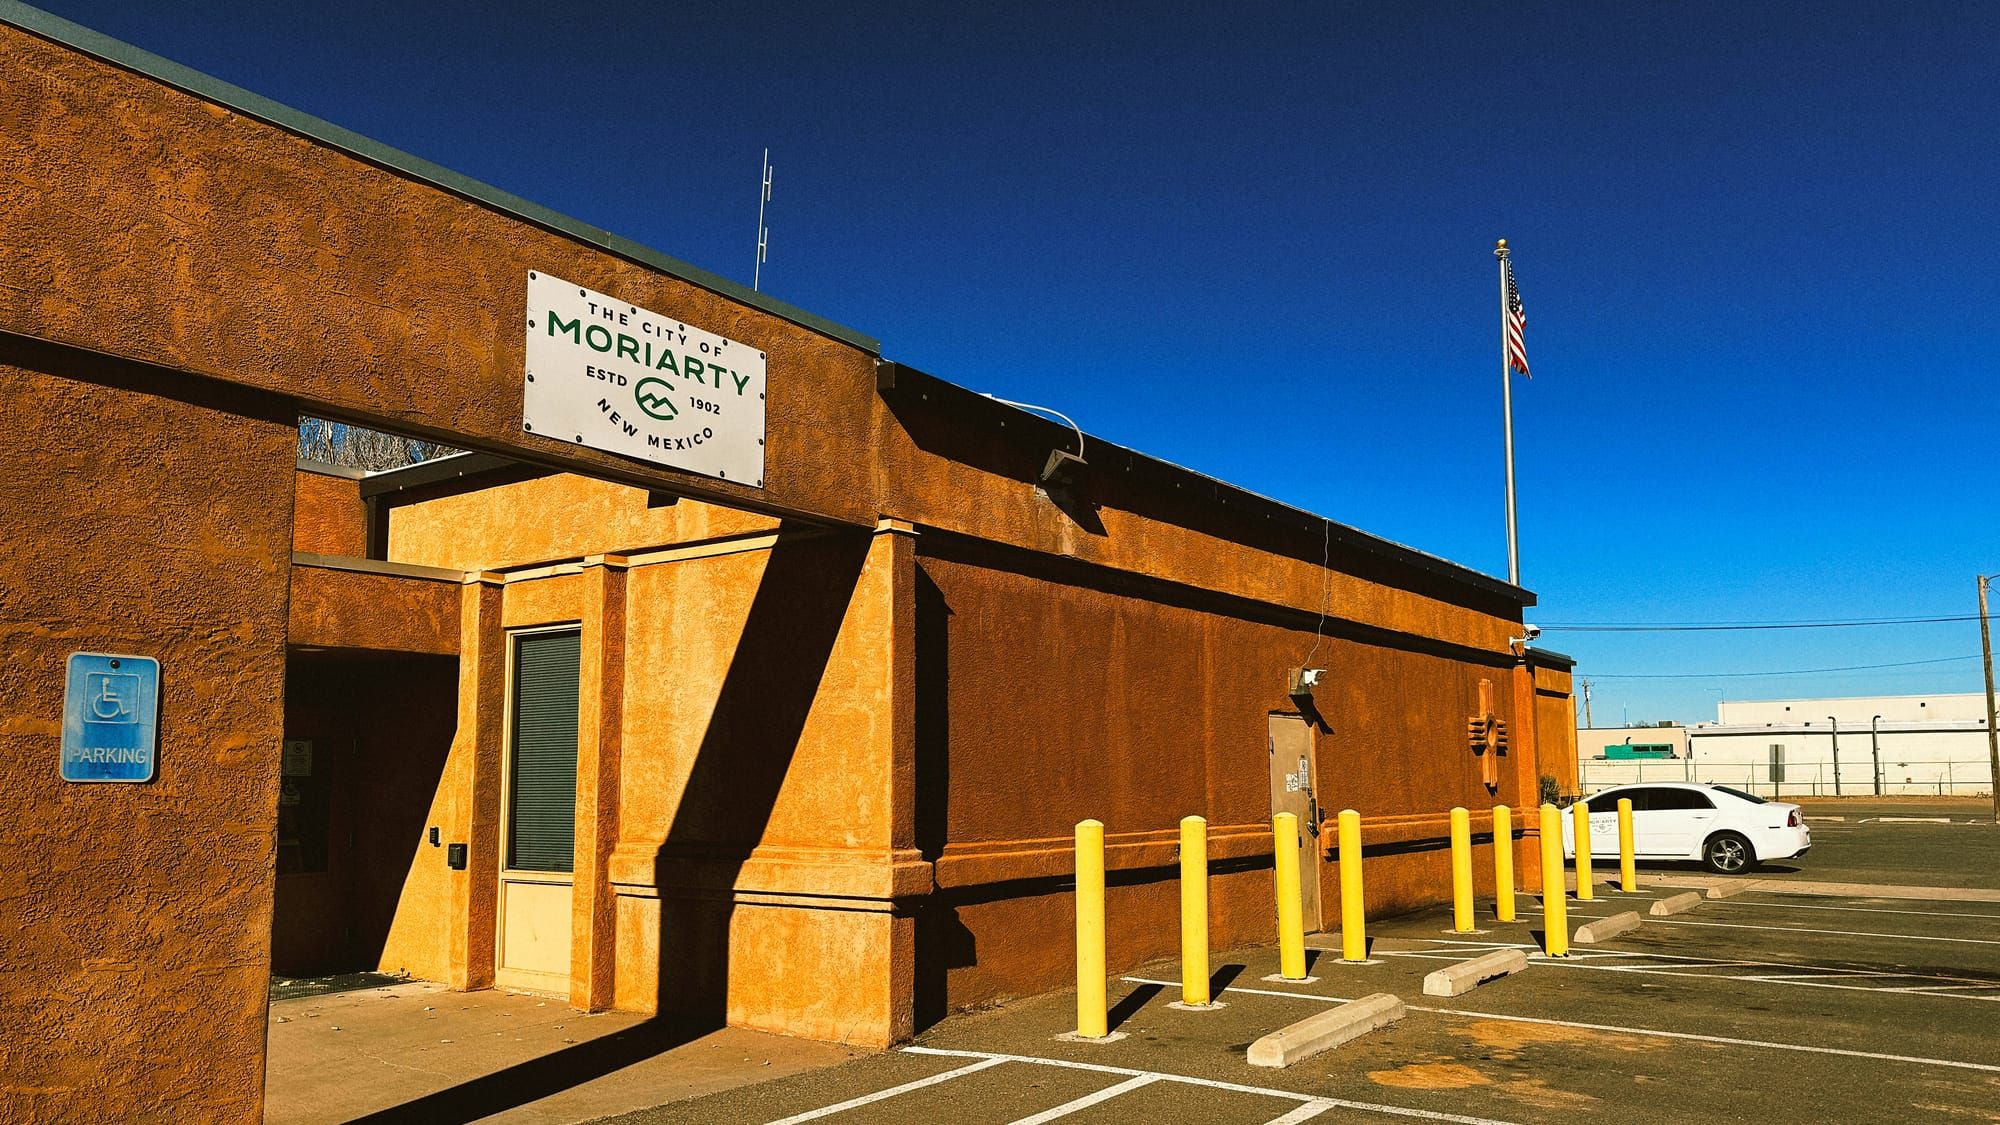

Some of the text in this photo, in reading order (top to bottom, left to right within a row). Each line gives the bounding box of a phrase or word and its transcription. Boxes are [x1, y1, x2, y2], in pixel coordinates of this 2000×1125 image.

[547, 310, 751, 396] MORIARTY
[588, 302, 722, 358] THE CITY OF
[586, 365, 721, 416] ESTD 1902
[597, 398, 713, 451] NEW MEXICO
[69, 747, 146, 764] PARKING
